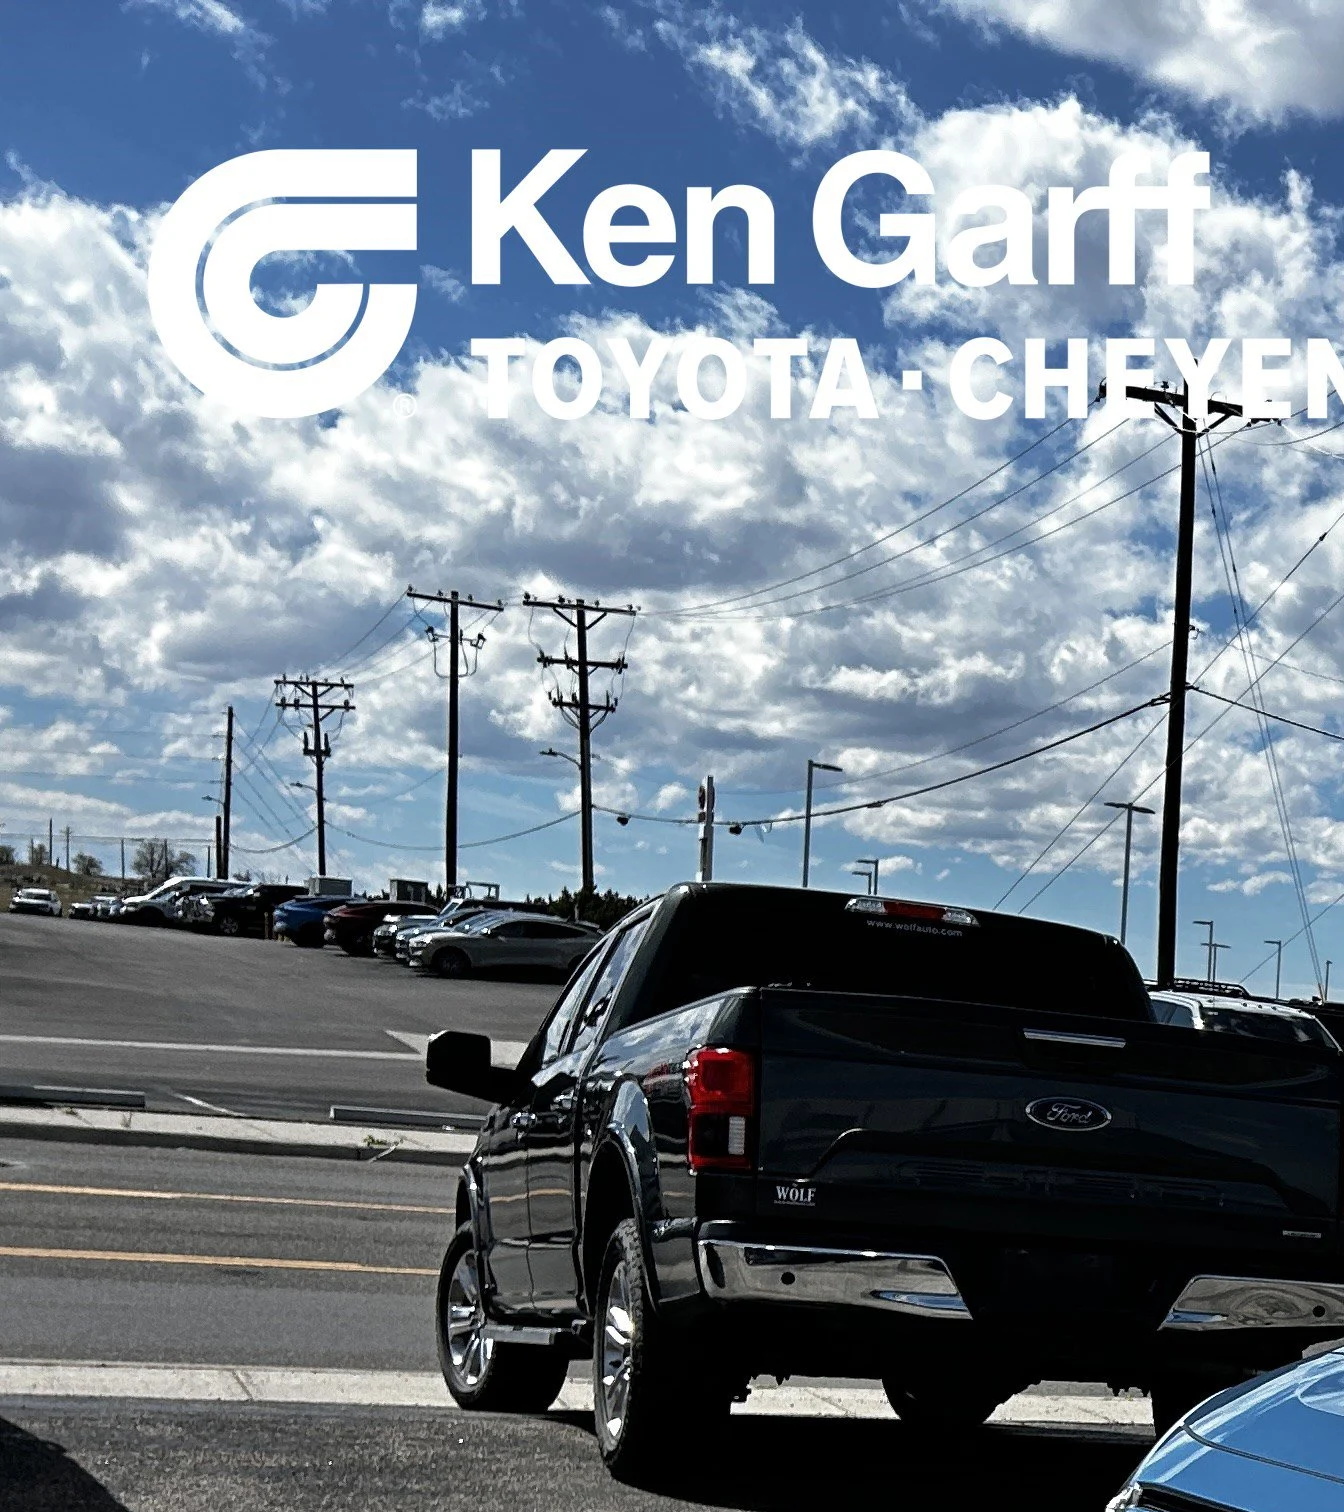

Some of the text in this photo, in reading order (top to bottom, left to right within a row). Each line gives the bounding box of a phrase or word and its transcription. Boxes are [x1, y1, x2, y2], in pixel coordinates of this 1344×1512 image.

[866, 919, 963, 936] www.wolfauto.com
[1047, 1102, 1092, 1123] Ford
[776, 1185, 816, 1202] WOLF
